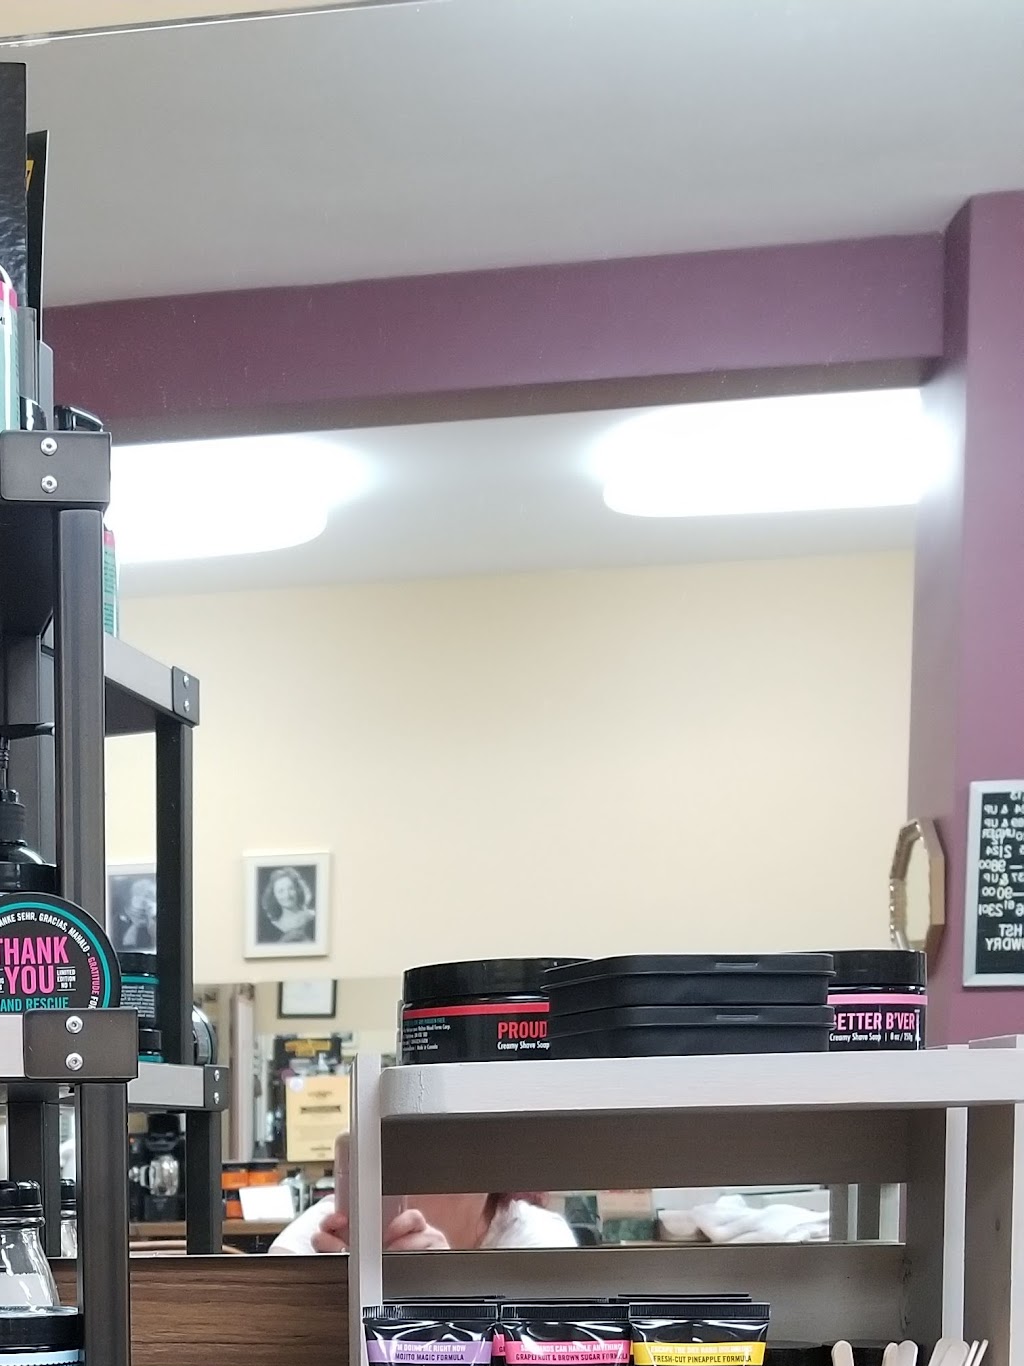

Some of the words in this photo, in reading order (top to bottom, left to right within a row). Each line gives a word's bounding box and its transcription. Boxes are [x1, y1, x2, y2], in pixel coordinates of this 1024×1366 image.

[3, 966, 55, 994] YOU
[498, 1021, 547, 1039] PROUD
[886, 1012, 915, 1030] B'VER
